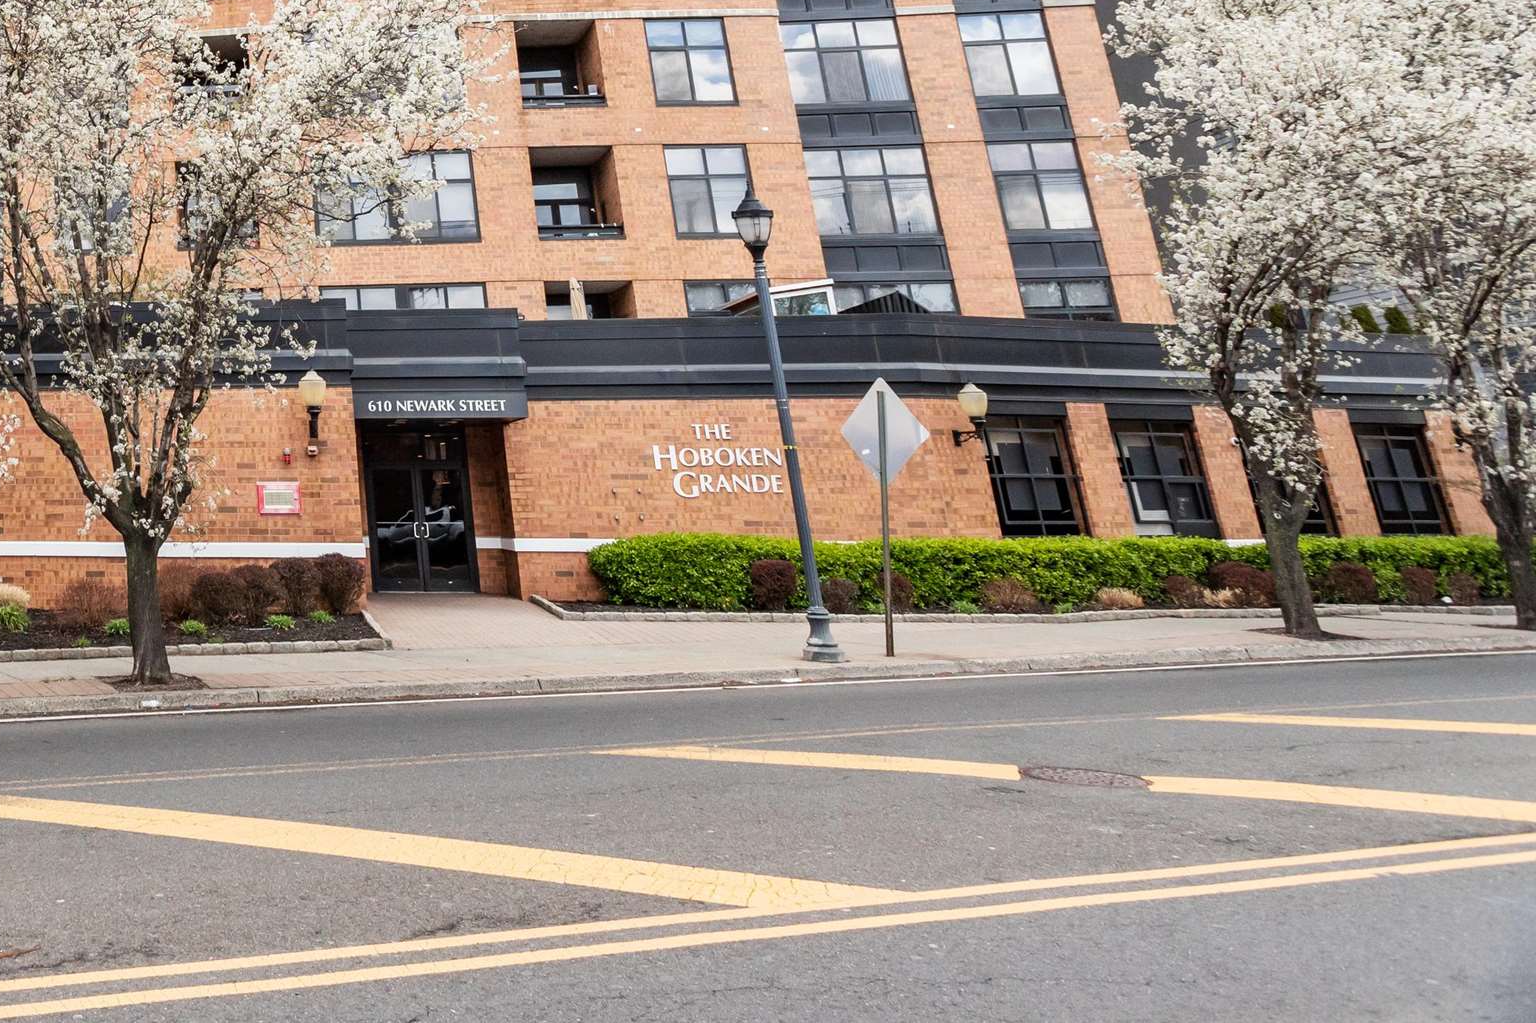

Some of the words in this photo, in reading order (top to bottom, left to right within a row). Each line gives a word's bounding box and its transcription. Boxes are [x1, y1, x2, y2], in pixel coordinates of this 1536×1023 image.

[368, 400, 392, 412] 610
[396, 399, 457, 412] NEWARK
[459, 399, 506, 412] STREET
[691, 423, 732, 440] THE
[652, 445, 783, 471] HOBOKEN
[673, 471, 784, 498] GRANDE
